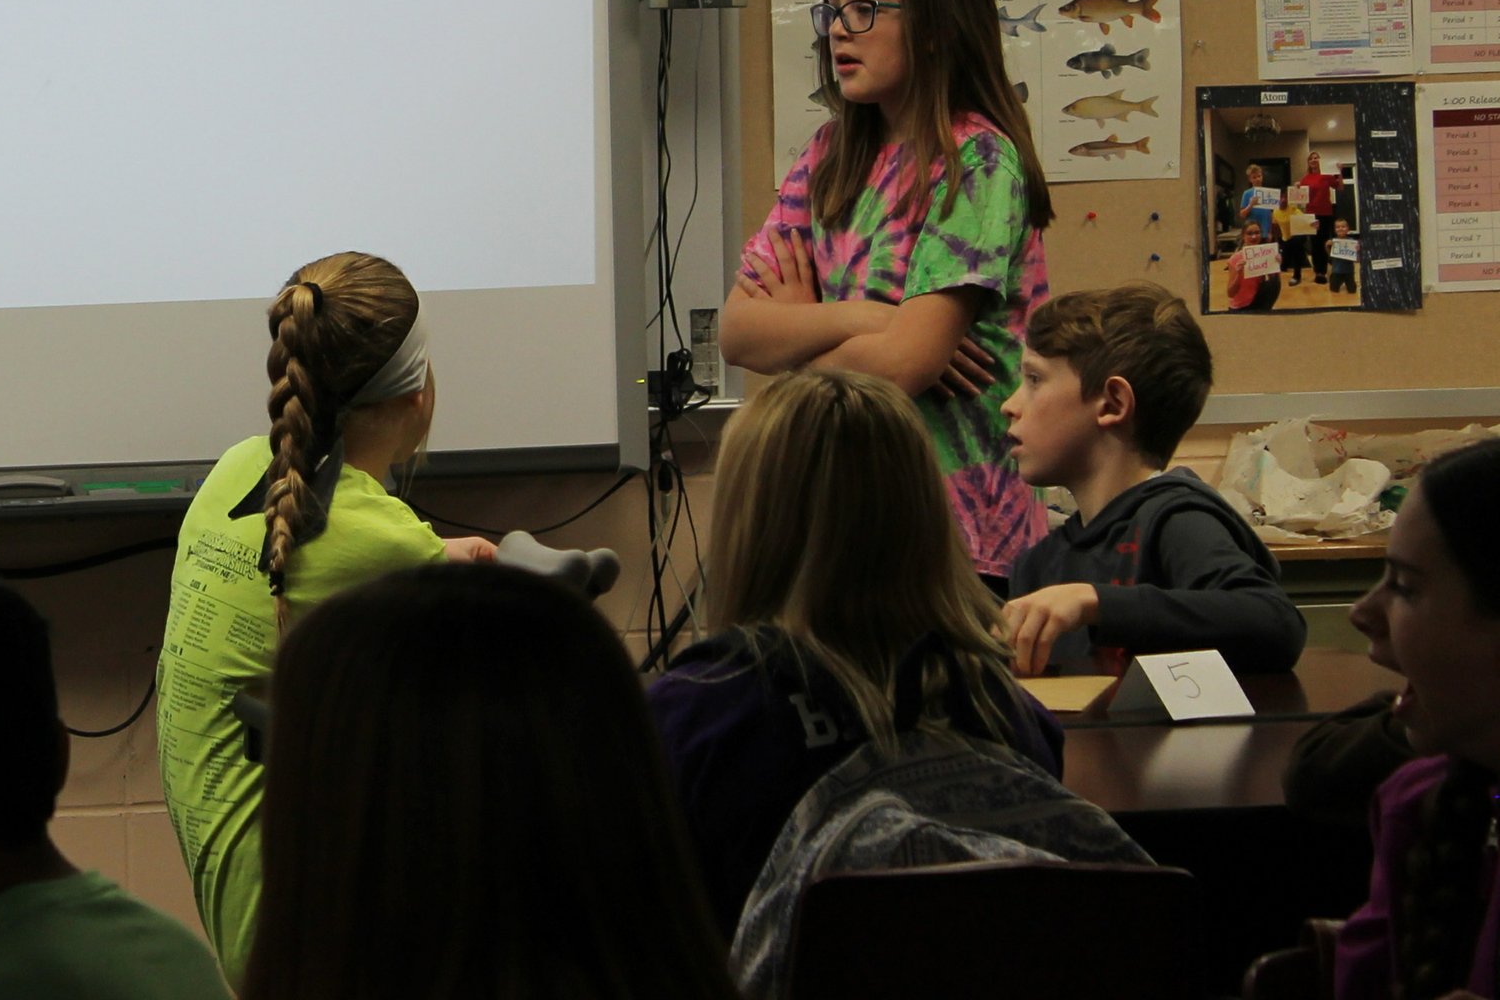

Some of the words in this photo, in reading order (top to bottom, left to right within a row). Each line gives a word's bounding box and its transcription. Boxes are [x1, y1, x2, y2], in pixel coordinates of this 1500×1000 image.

[1261, 92, 1287, 101] Atom
[1474, 113, 1486, 121] NO
[1451, 217, 1479, 225] LUNCH
[1166, 661, 1202, 700] 5
